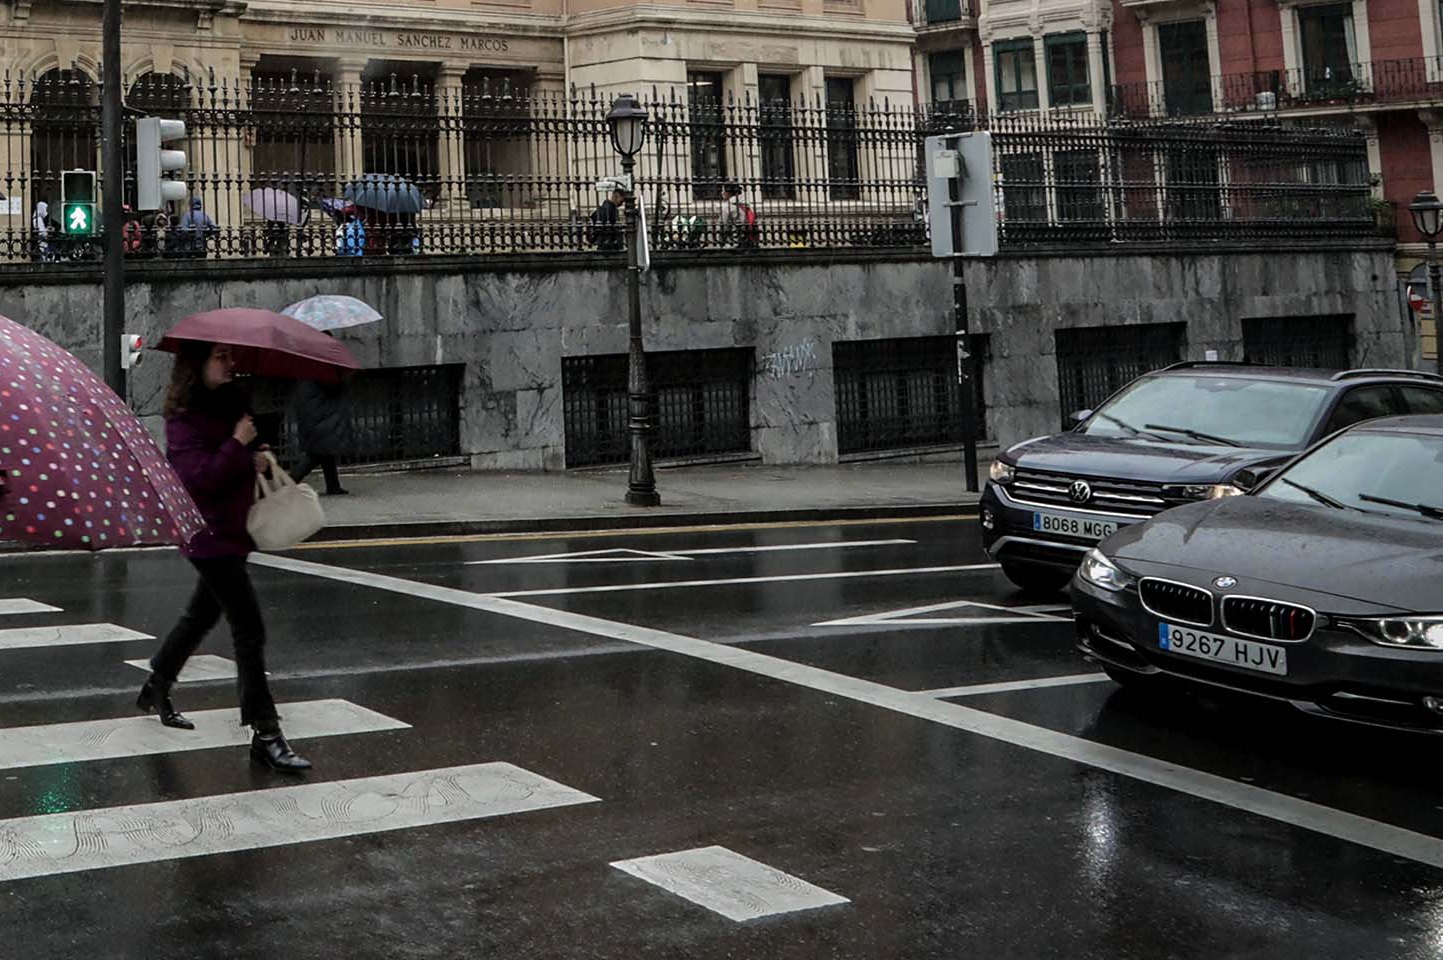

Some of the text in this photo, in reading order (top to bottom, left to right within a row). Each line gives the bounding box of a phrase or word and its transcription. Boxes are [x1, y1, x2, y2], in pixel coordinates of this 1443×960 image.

[290, 29, 508, 52] JUAN MANUEL SANCHEZ MARCOS
[1043, 516, 1112, 537] 8068 MGG
[1172, 629, 1279, 669] 9267 HJV
